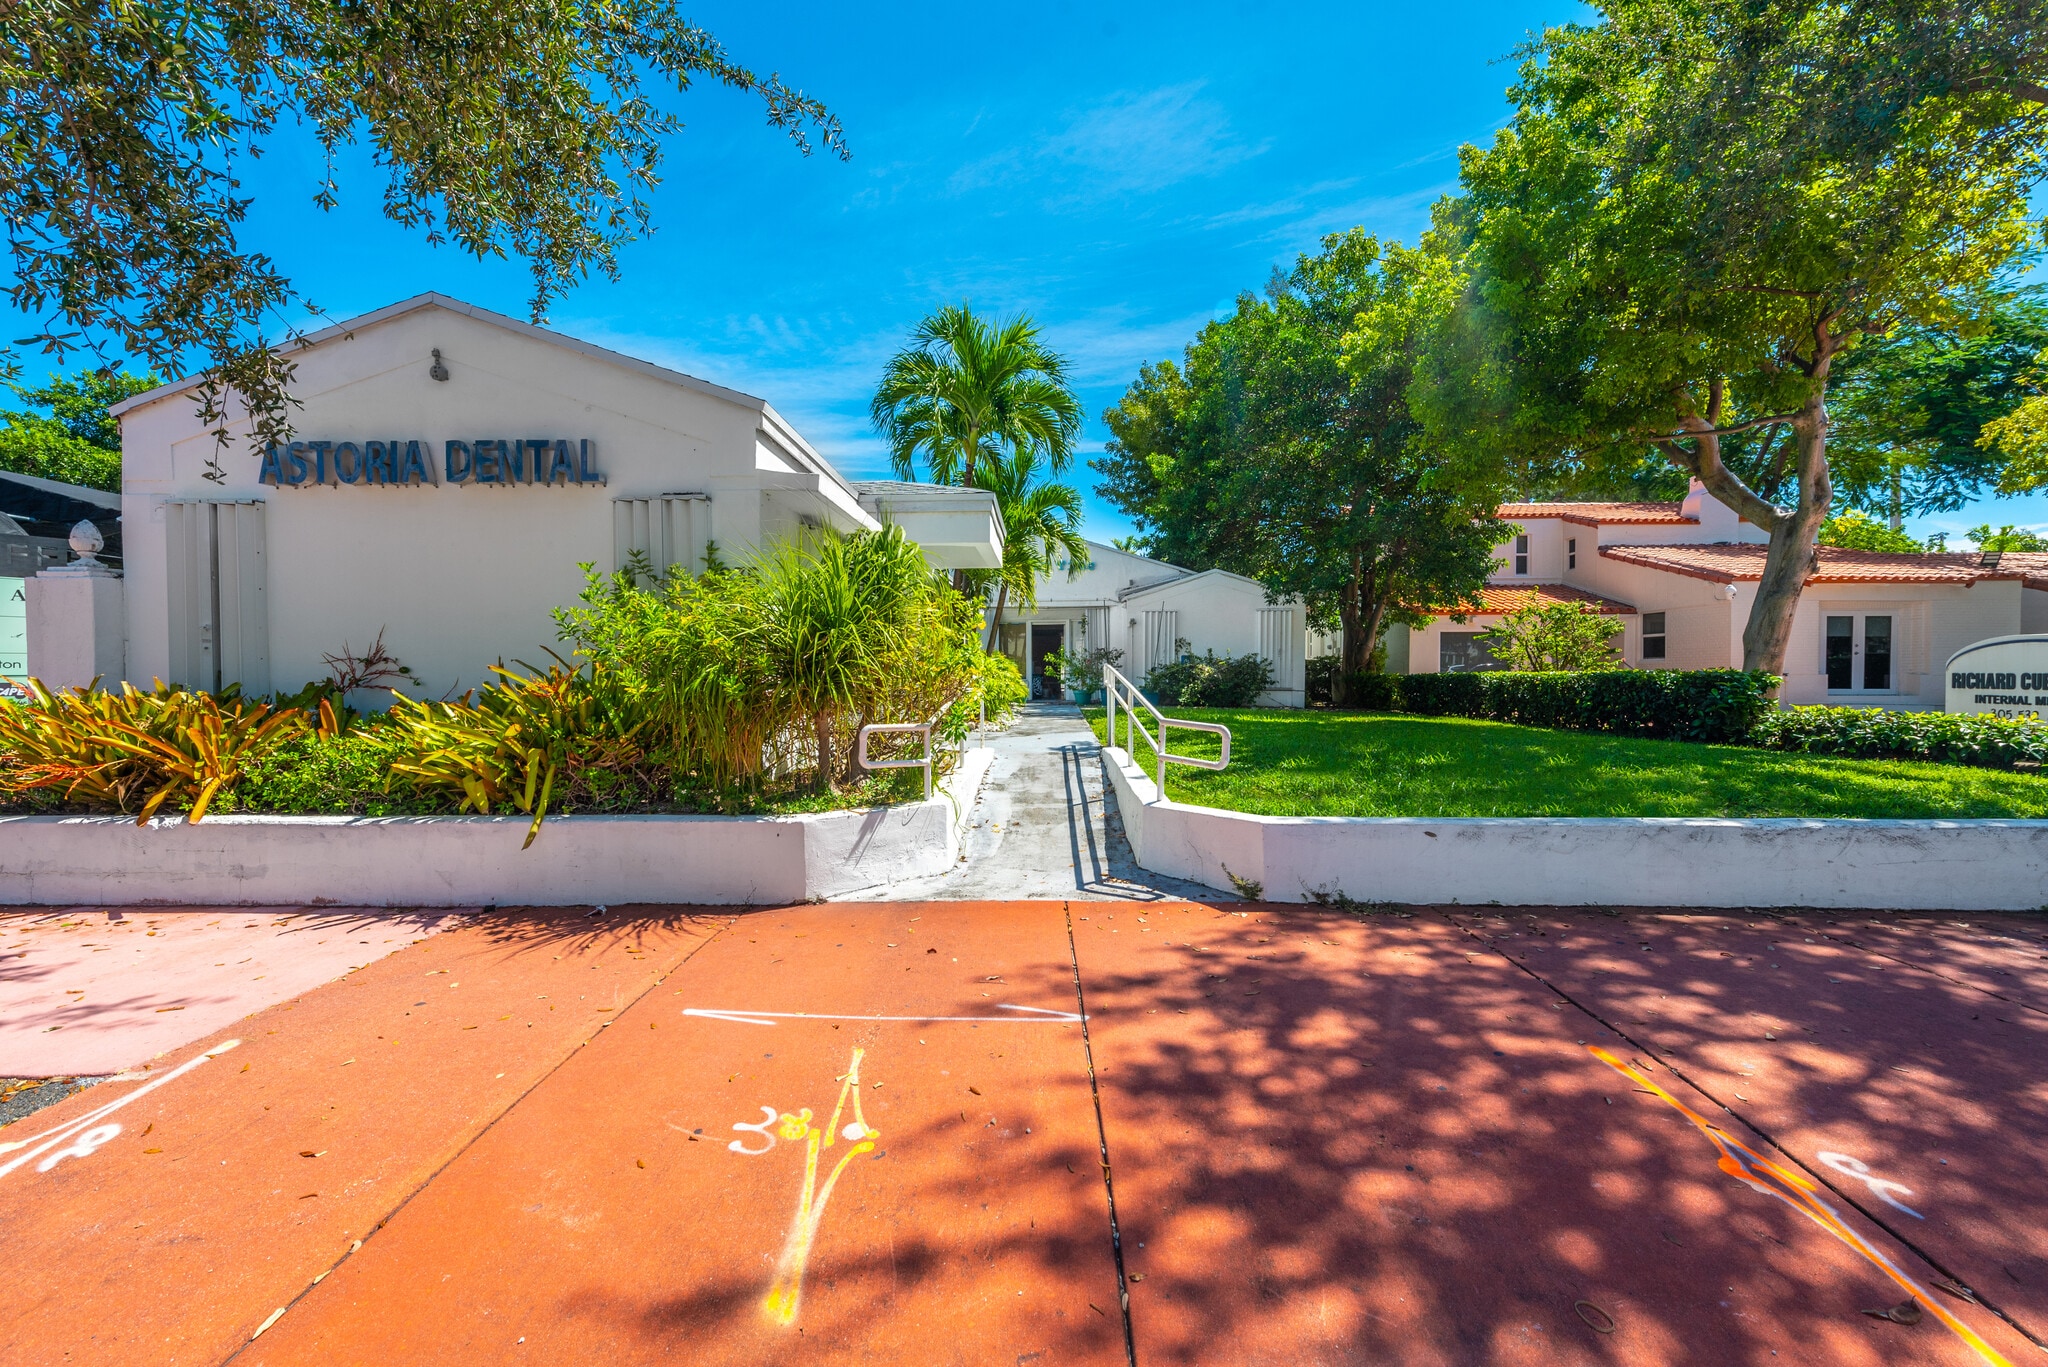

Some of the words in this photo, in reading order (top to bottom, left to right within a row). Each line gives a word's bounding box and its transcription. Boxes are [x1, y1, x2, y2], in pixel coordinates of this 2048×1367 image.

[258, 440, 429, 484] ASTORIA
[445, 438, 600, 483] DENTAL
[0, 661, 22, 669] on
[1951, 672, 2016, 689] RICHARD
[0, 687, 26, 697] APE
[1974, 694, 2032, 705] INTERNAL
